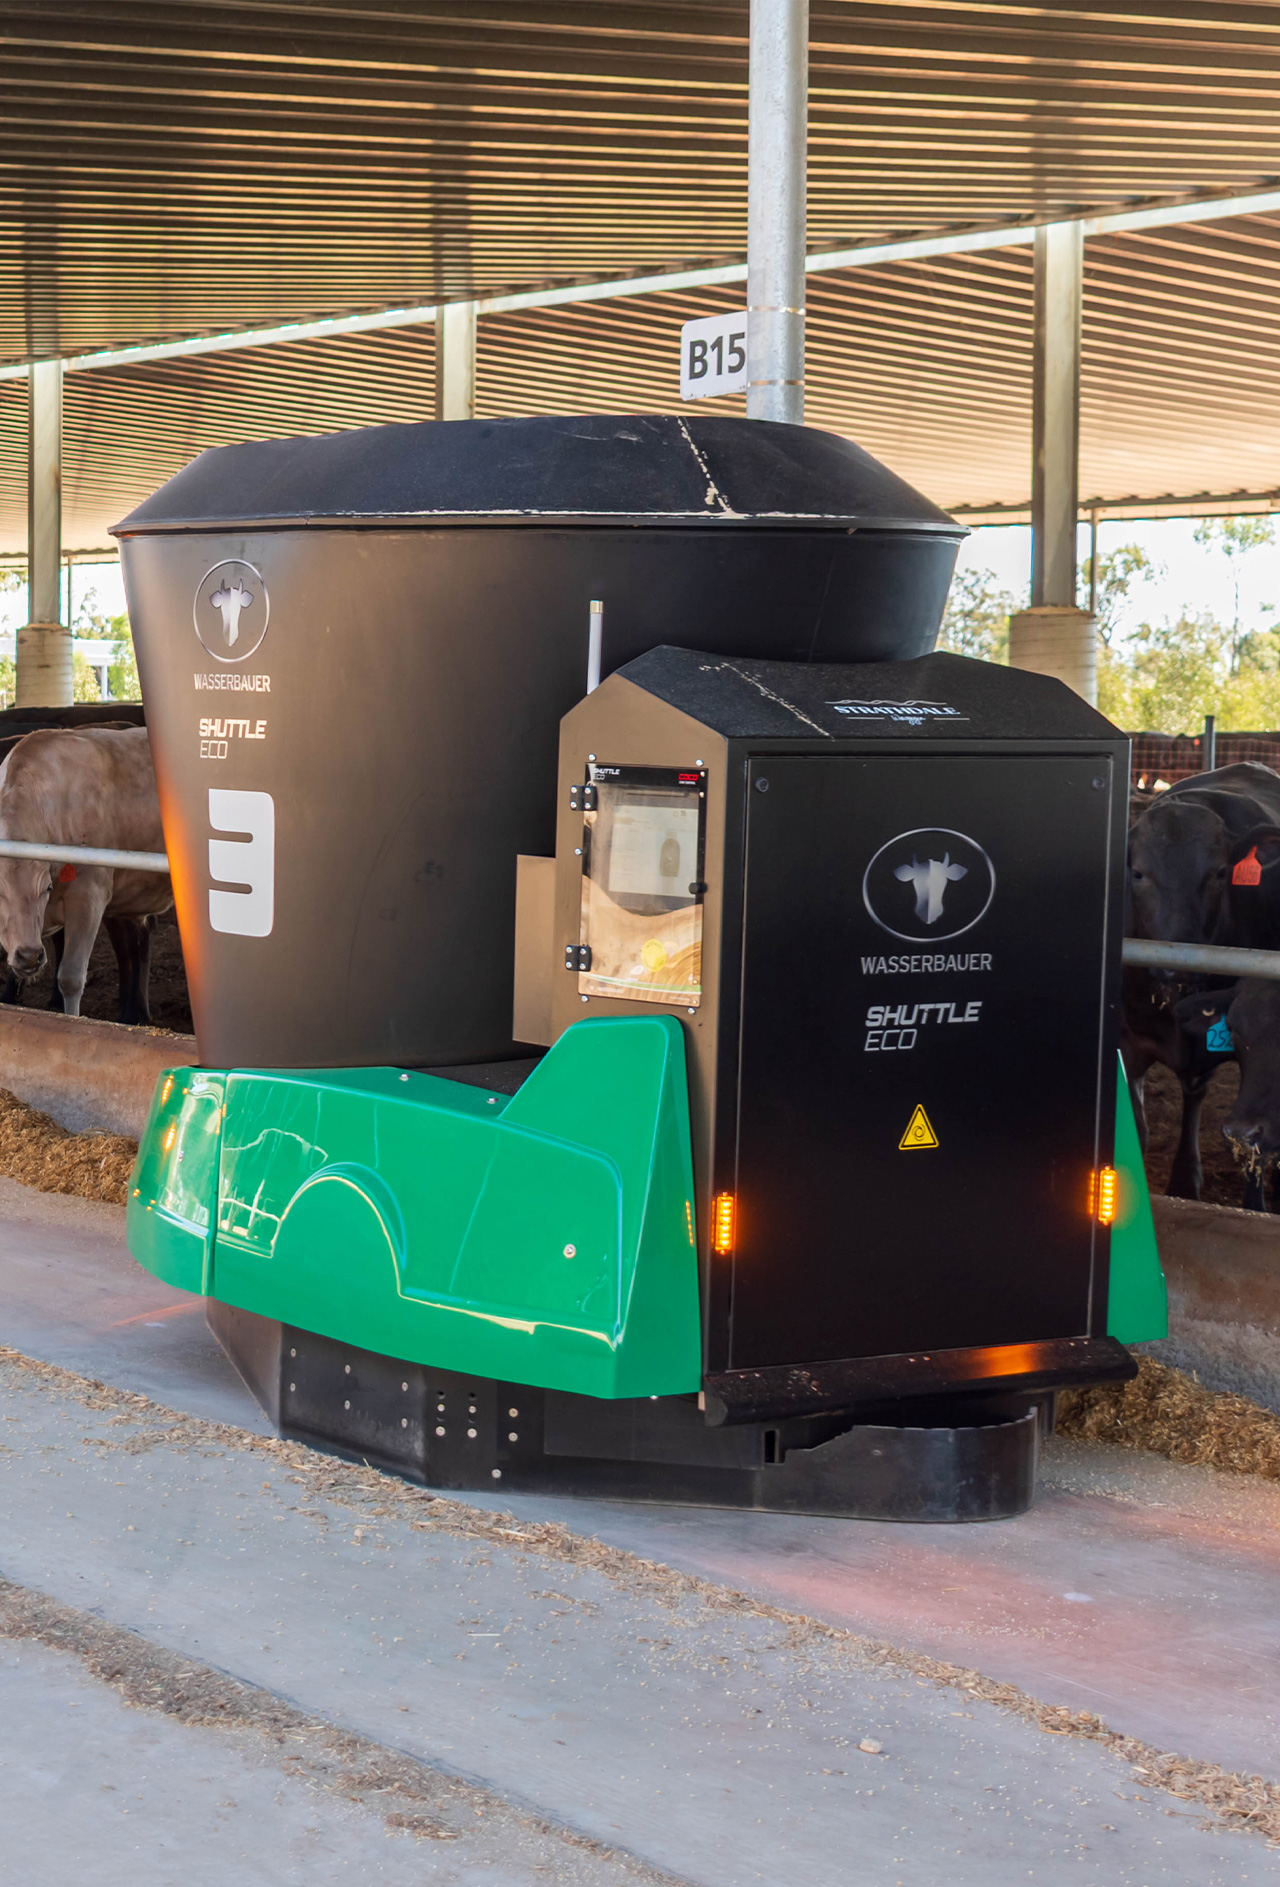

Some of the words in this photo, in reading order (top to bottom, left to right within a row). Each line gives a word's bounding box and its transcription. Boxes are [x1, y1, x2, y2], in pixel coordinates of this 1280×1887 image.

[688, 332, 746, 380] B15
[194, 673, 271, 692] WASSERBAUER
[833, 706, 962, 715] STRATHDALE
[199, 718, 267, 739] SHUTTLE
[200, 740, 228, 759] ECO
[208, 788, 275, 938] 3
[860, 953, 993, 975] WASSERBAUER
[865, 1001, 982, 1027] SHUTTLE
[864, 1028, 918, 1051] ECO
